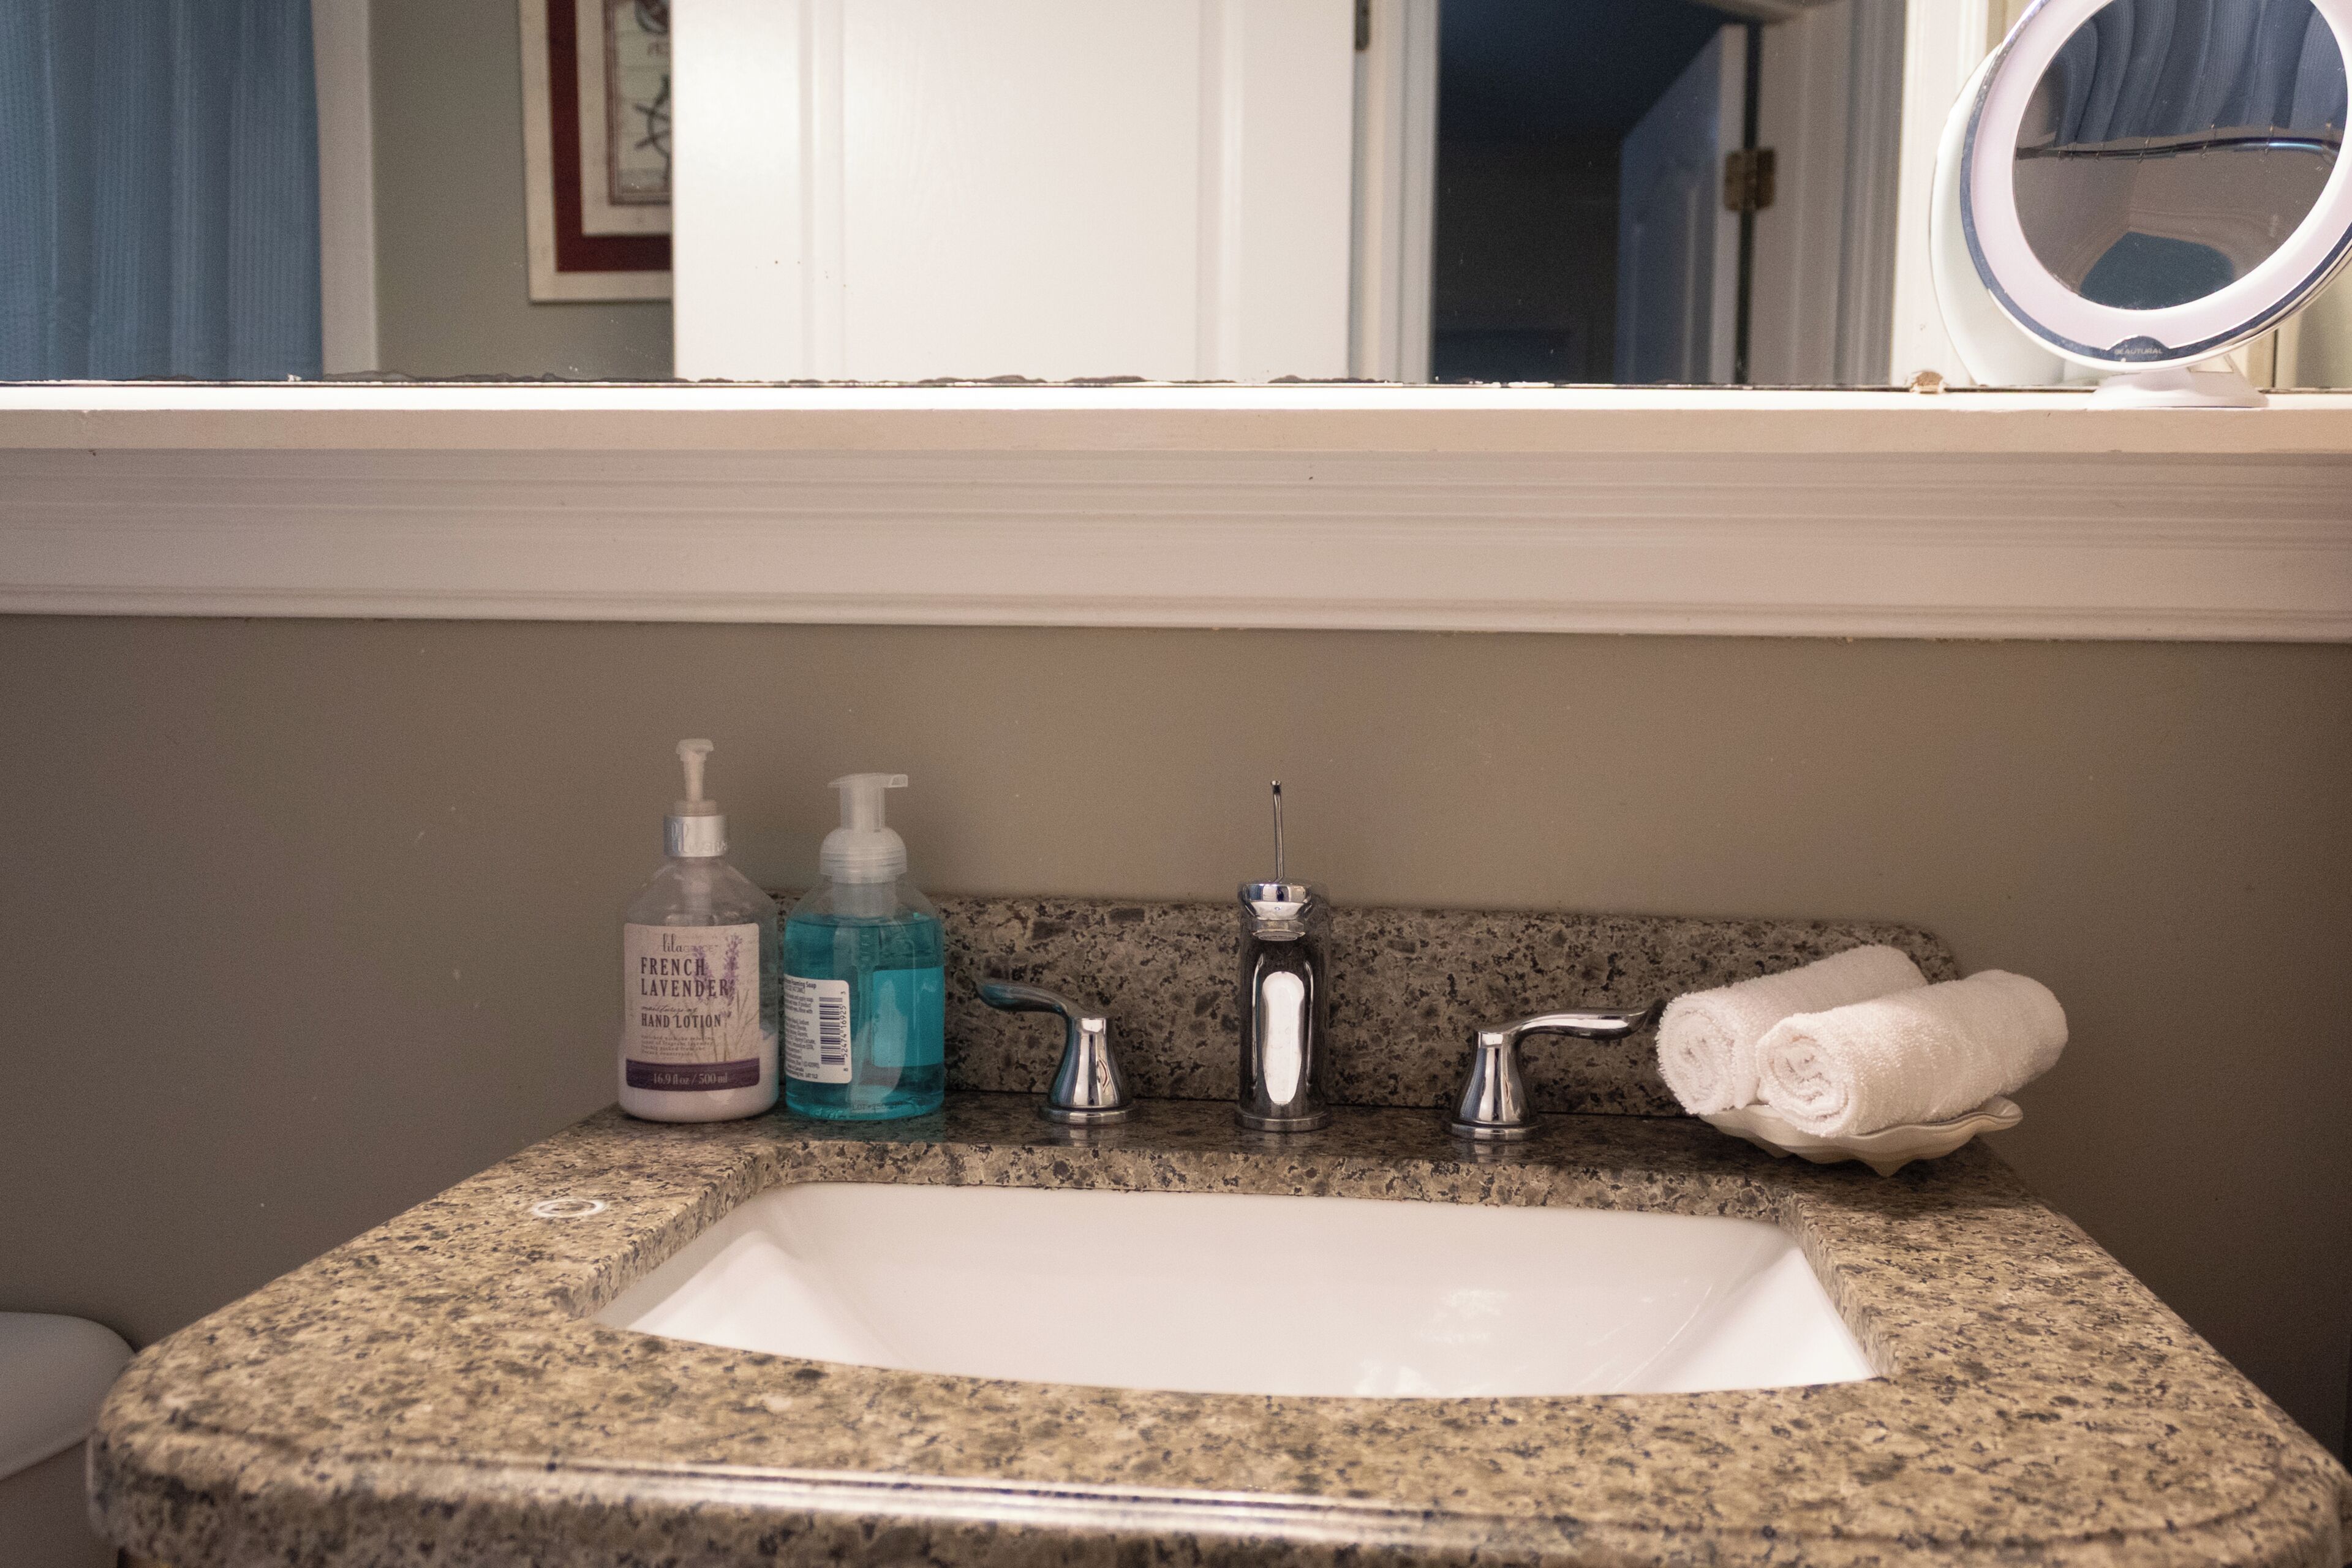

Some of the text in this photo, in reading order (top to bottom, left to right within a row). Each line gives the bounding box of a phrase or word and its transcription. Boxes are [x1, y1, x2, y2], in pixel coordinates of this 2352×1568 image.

[641, 957, 705, 976] FRENCH
[641, 978, 729, 998] LAVENDER
[806, 981, 816, 990] Soap
[641, 1012, 722, 1028] HAND LOTION
[653, 1072, 671, 1084] 16.9
[698, 1072, 716, 1085] 500
